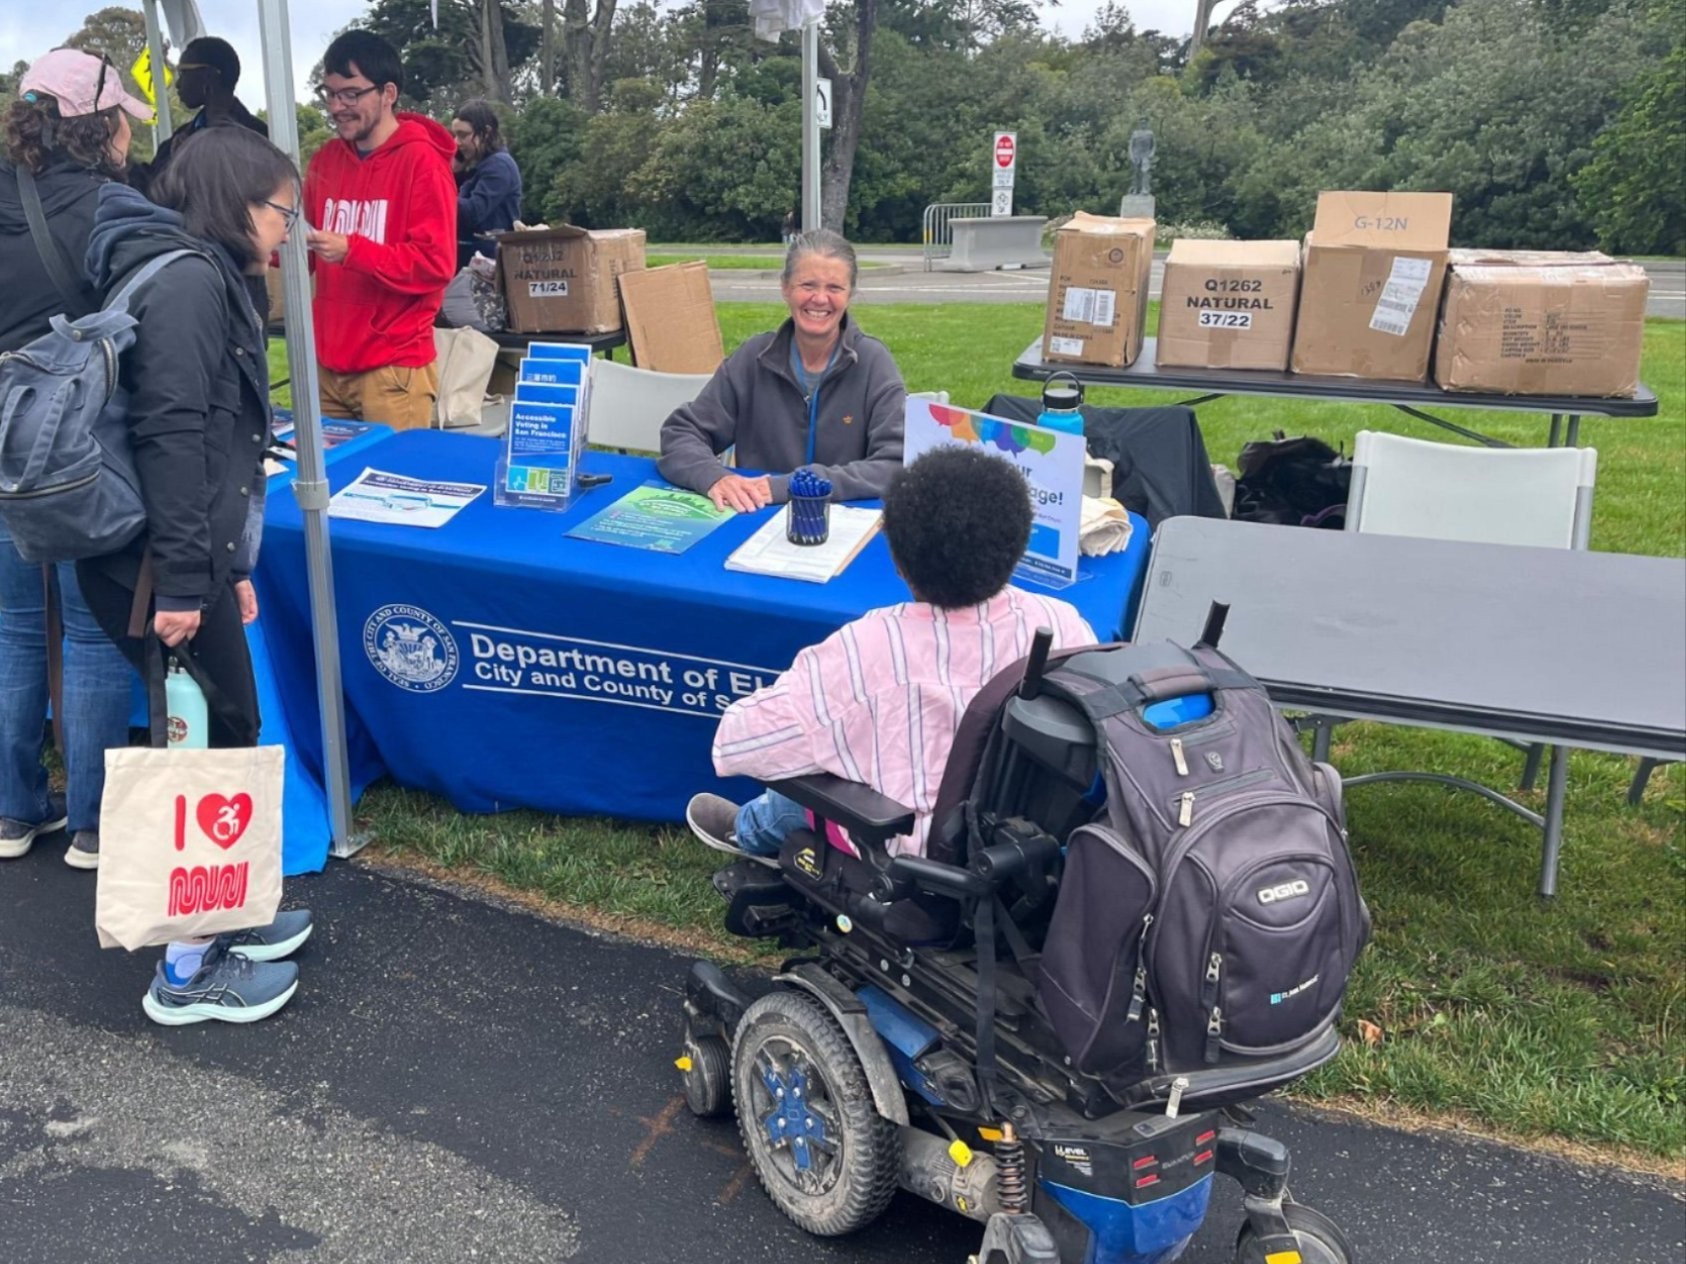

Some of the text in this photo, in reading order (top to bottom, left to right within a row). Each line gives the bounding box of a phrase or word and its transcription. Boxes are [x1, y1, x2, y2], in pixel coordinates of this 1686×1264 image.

[1354, 216, 1408, 231] G-12N
[514, 268, 577, 280] NATURAL
[530, 282, 567, 293] 71/24
[1204, 279, 1262, 292] Q1262
[1187, 296, 1274, 310] NATURAL
[1200, 312, 1250, 327] 37/22
[515, 413, 557, 423] Accessible
[515, 421, 540, 430] Voting
[515, 428, 567, 439] San Francisco
[1029, 486, 1063, 506] age!
[375, 607, 393, 621] AND
[393, 606, 433, 624] COUNTY
[432, 623, 445, 635] OF
[442, 635, 456, 654] SAN
[470, 633, 764, 696] Department of El
[475, 661, 731, 710] City and County of S
[174, 794, 186, 851] I
[1258, 880, 1309, 903] OGIO
